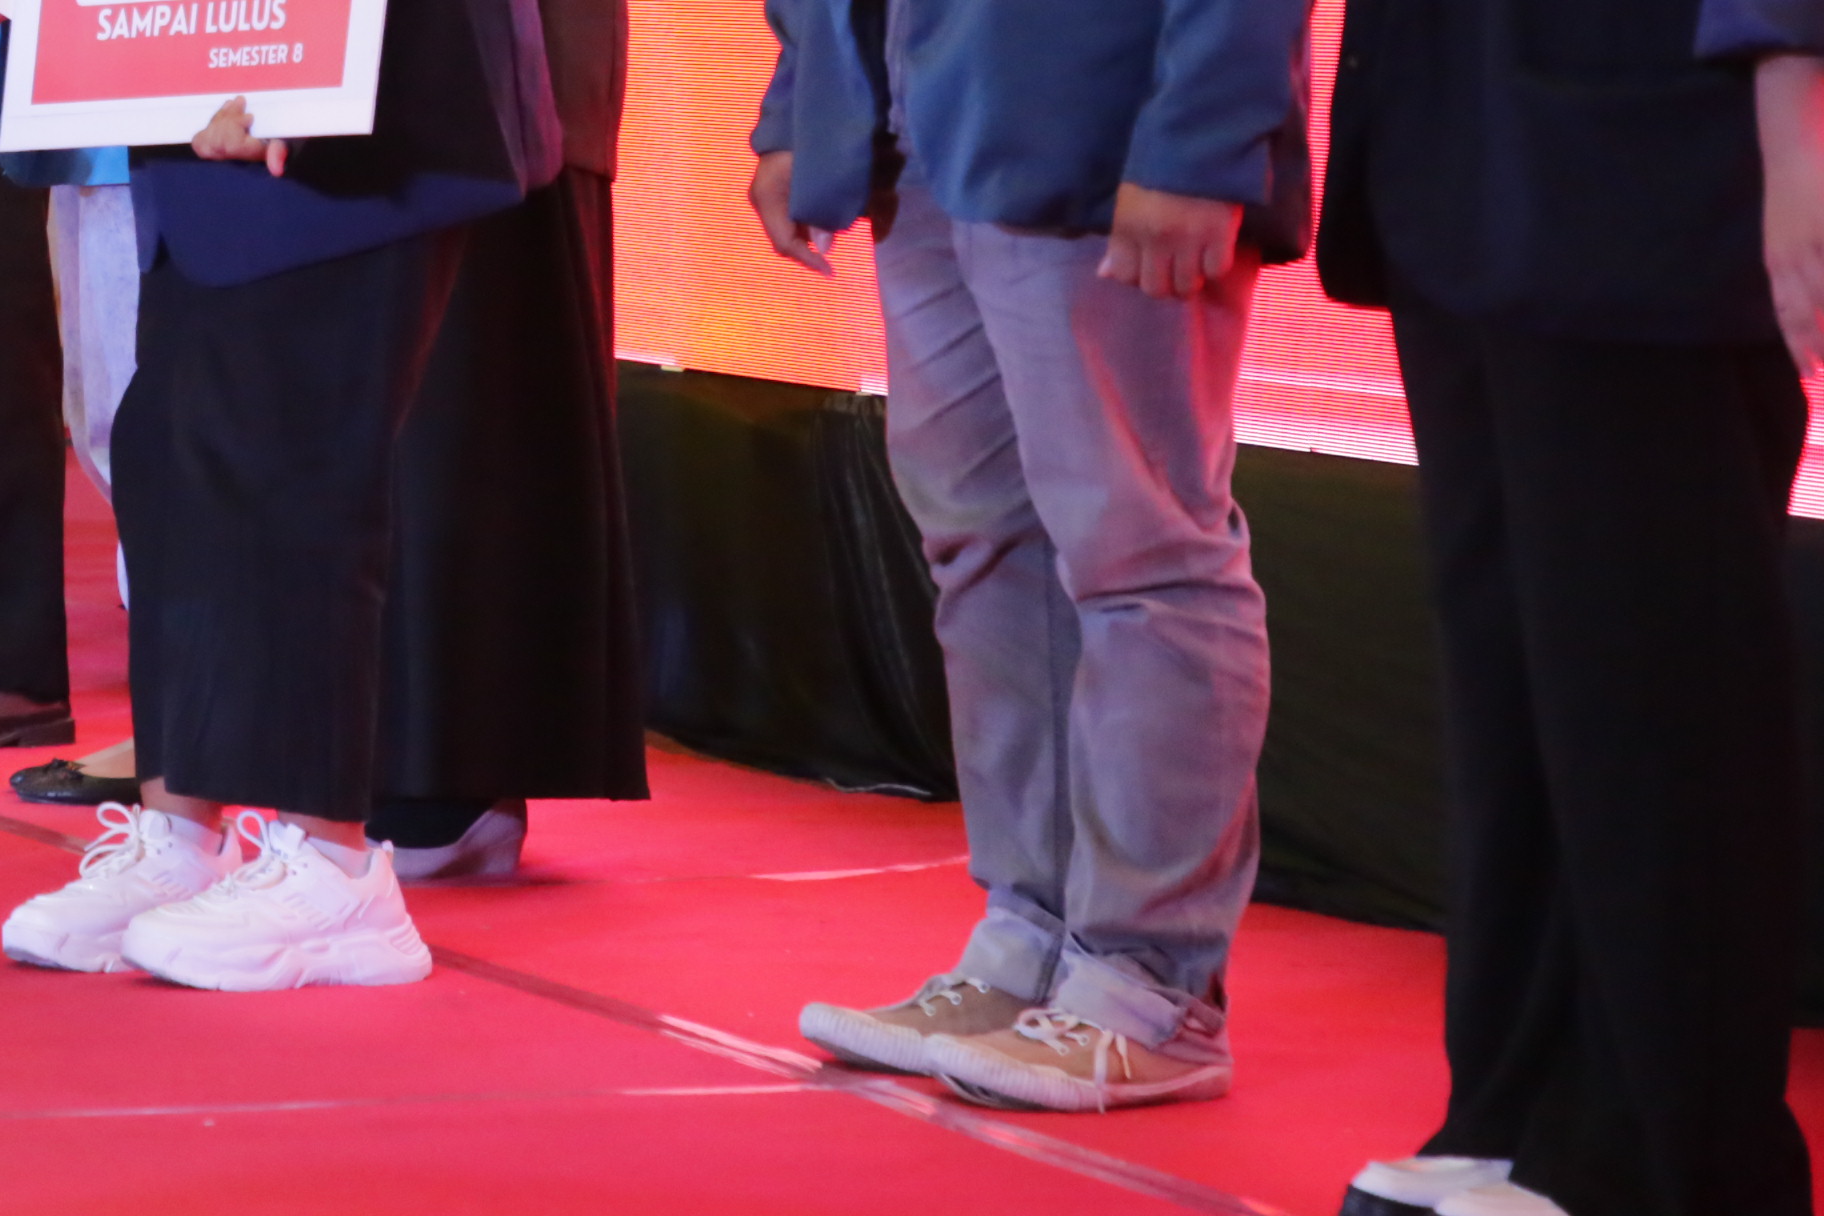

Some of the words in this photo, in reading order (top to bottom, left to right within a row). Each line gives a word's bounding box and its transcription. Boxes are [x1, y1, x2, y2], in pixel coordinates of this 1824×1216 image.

[96, 2, 198, 41] SAMPAI
[208, 43, 288, 69] SEMESTER
[292, 42, 304, 63] 8
